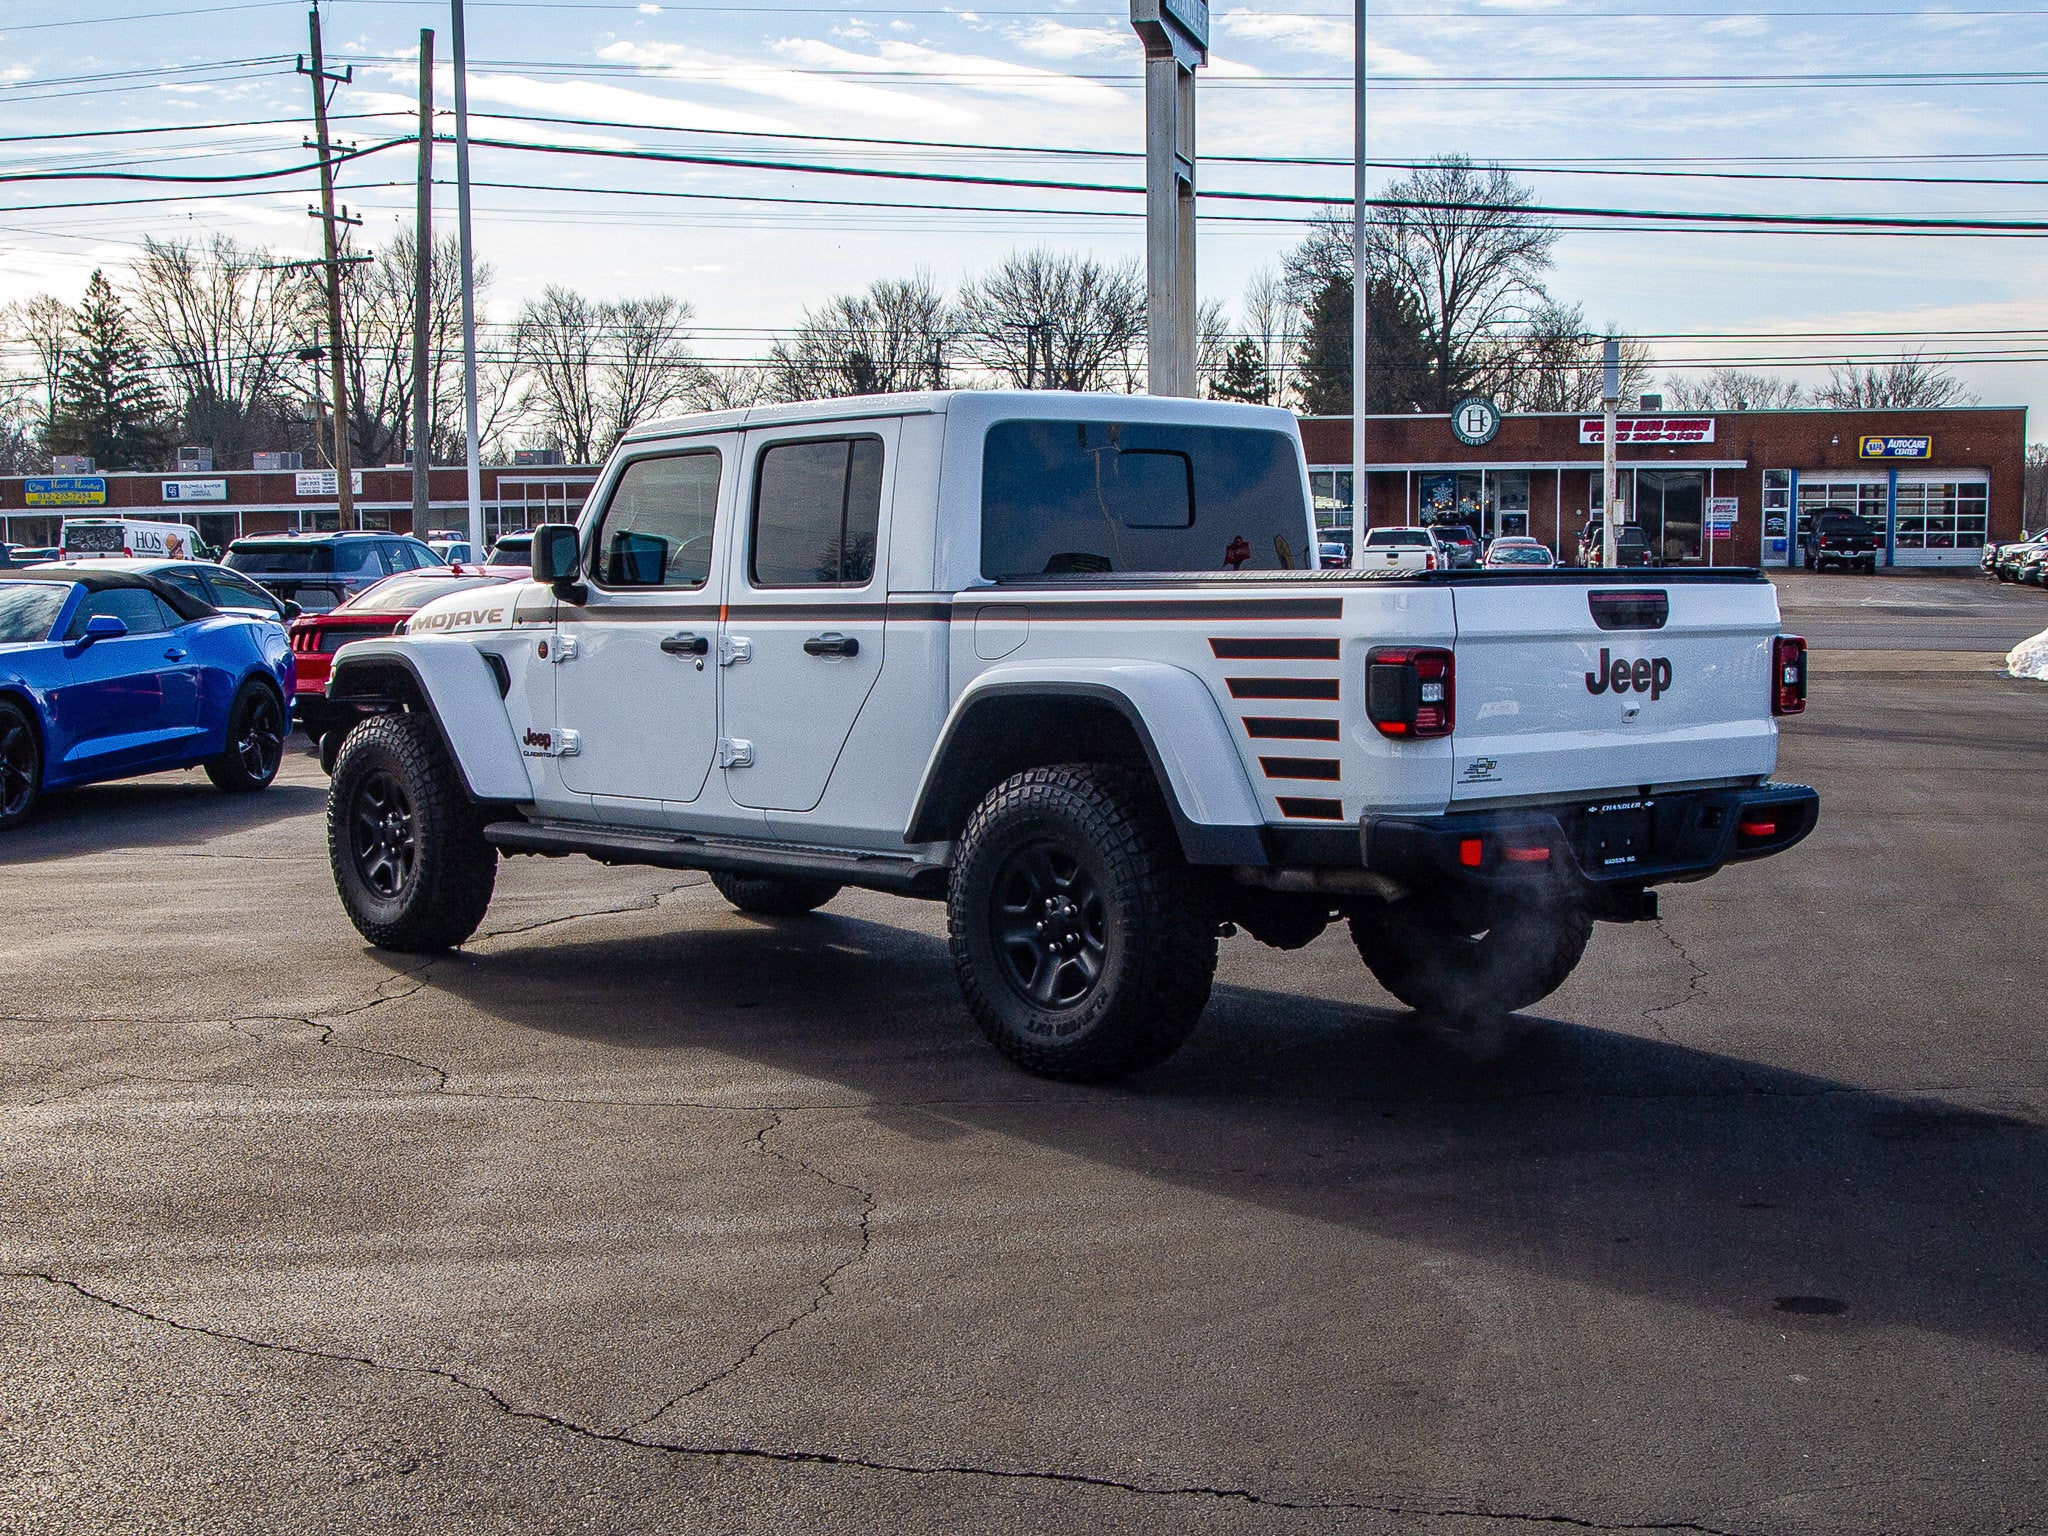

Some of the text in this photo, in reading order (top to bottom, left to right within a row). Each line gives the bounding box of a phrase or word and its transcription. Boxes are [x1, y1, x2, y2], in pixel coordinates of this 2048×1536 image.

[1634, 421, 1663, 432] AUTO
[1664, 420, 1711, 432] SERVICE
[1460, 434, 1489, 445] COFFEE
[1894, 448, 1919, 456] CENTER
[134, 531, 161, 550] HOS
[411, 607, 504, 631] MOJAVE
[1585, 647, 1672, 701] Jeep
[522, 727, 552, 751] Jeep
[1602, 802, 1641, 811] CHANDLER
